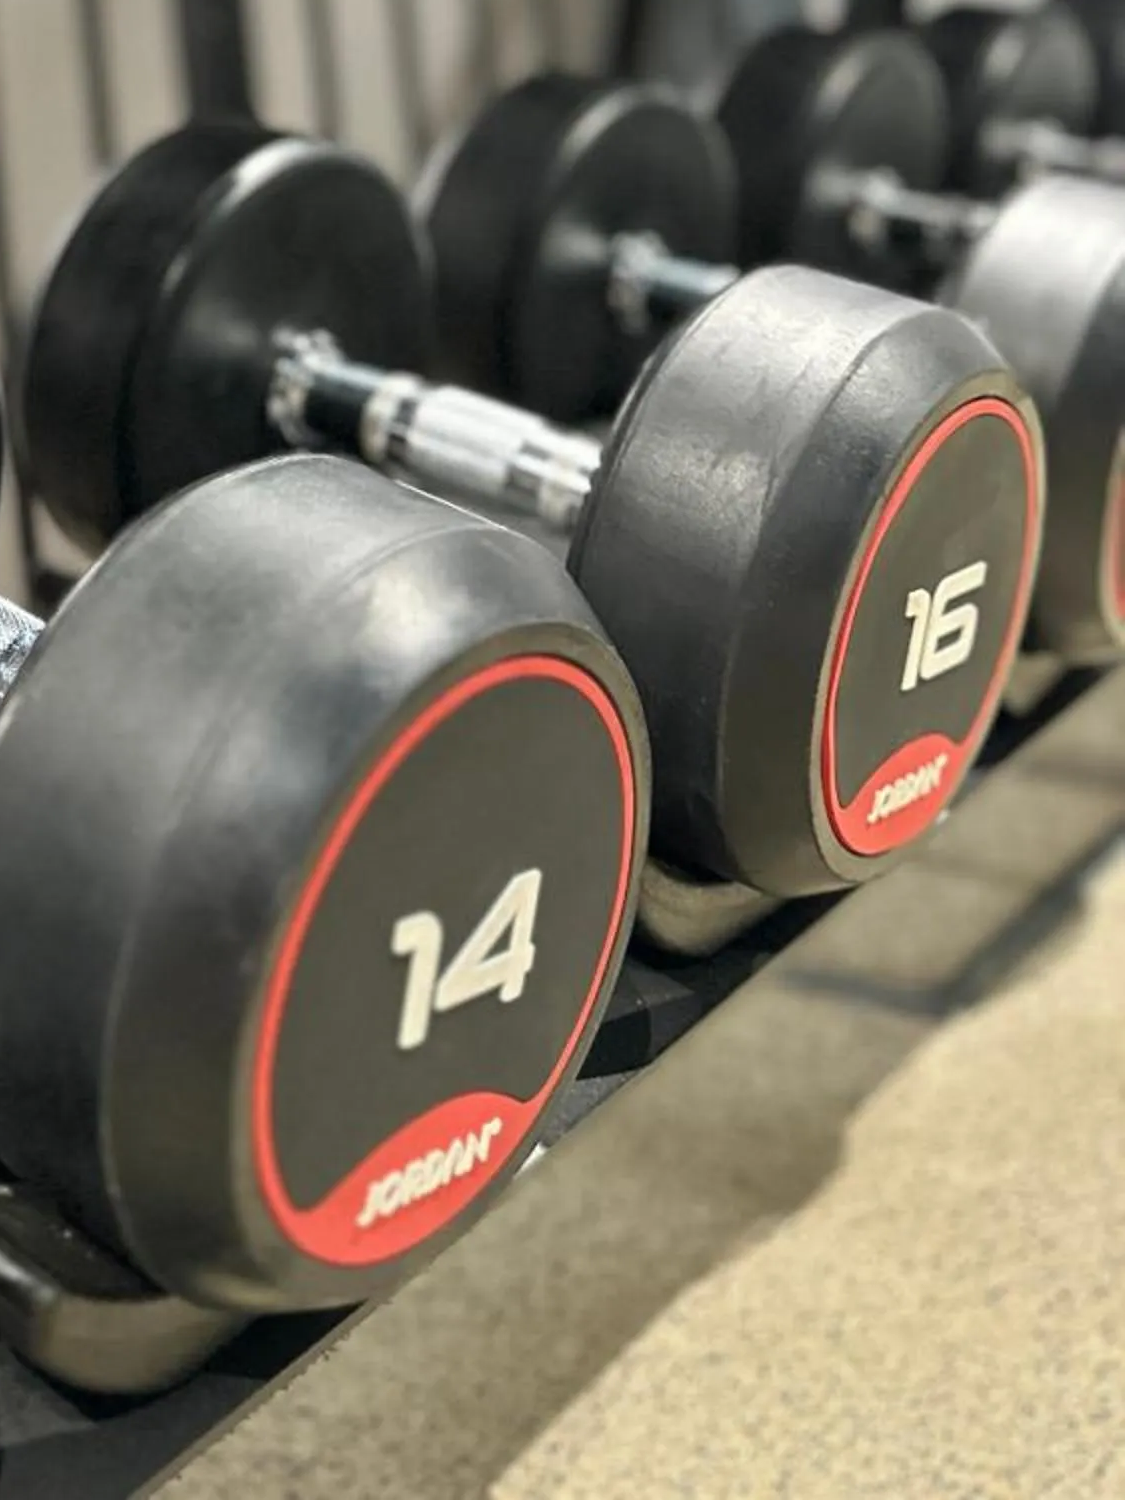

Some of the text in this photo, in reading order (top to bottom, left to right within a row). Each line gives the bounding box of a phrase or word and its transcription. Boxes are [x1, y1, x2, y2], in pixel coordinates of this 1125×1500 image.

[901, 560, 988, 691] 16
[391, 868, 543, 1050] 14
[357, 1124, 495, 1228] JORDAN
